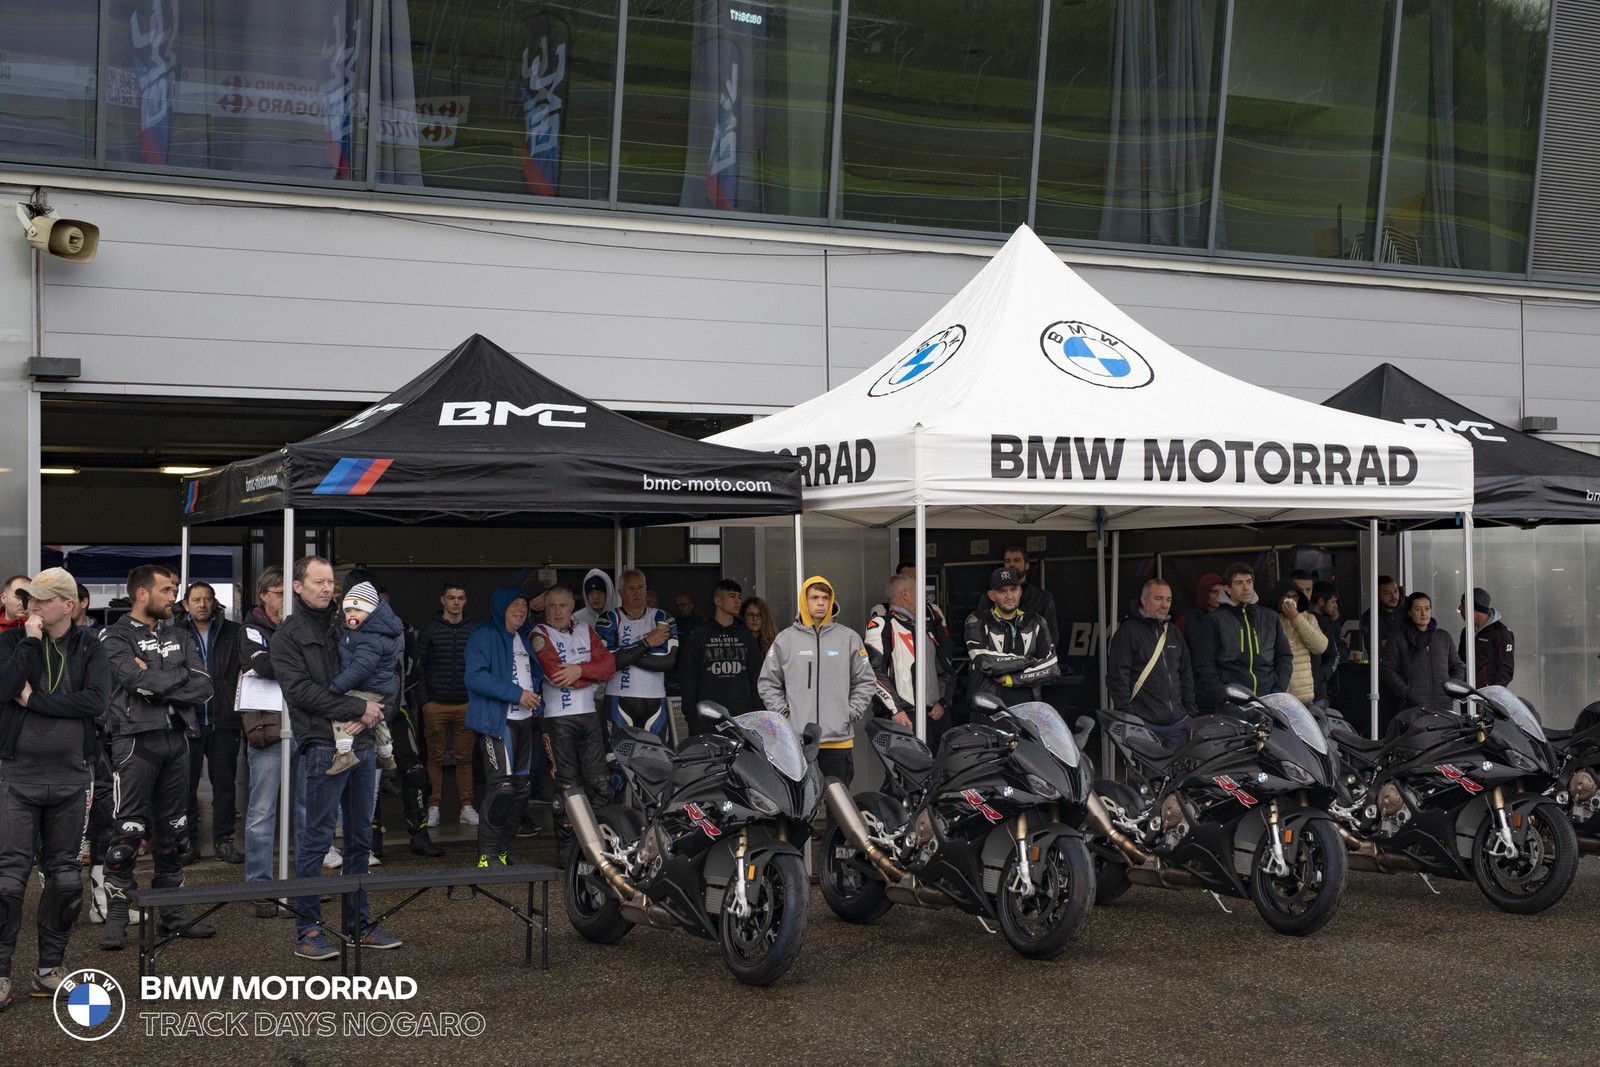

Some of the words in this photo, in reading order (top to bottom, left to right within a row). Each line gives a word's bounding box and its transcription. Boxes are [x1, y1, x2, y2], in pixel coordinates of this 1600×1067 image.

[438, 401, 587, 429] BMC
[990, 434, 1126, 480] BMW
[1143, 438, 1419, 486] MOTORRAD
[643, 474, 772, 492] bmc-moto.com
[711, 661, 742, 675] GOD
